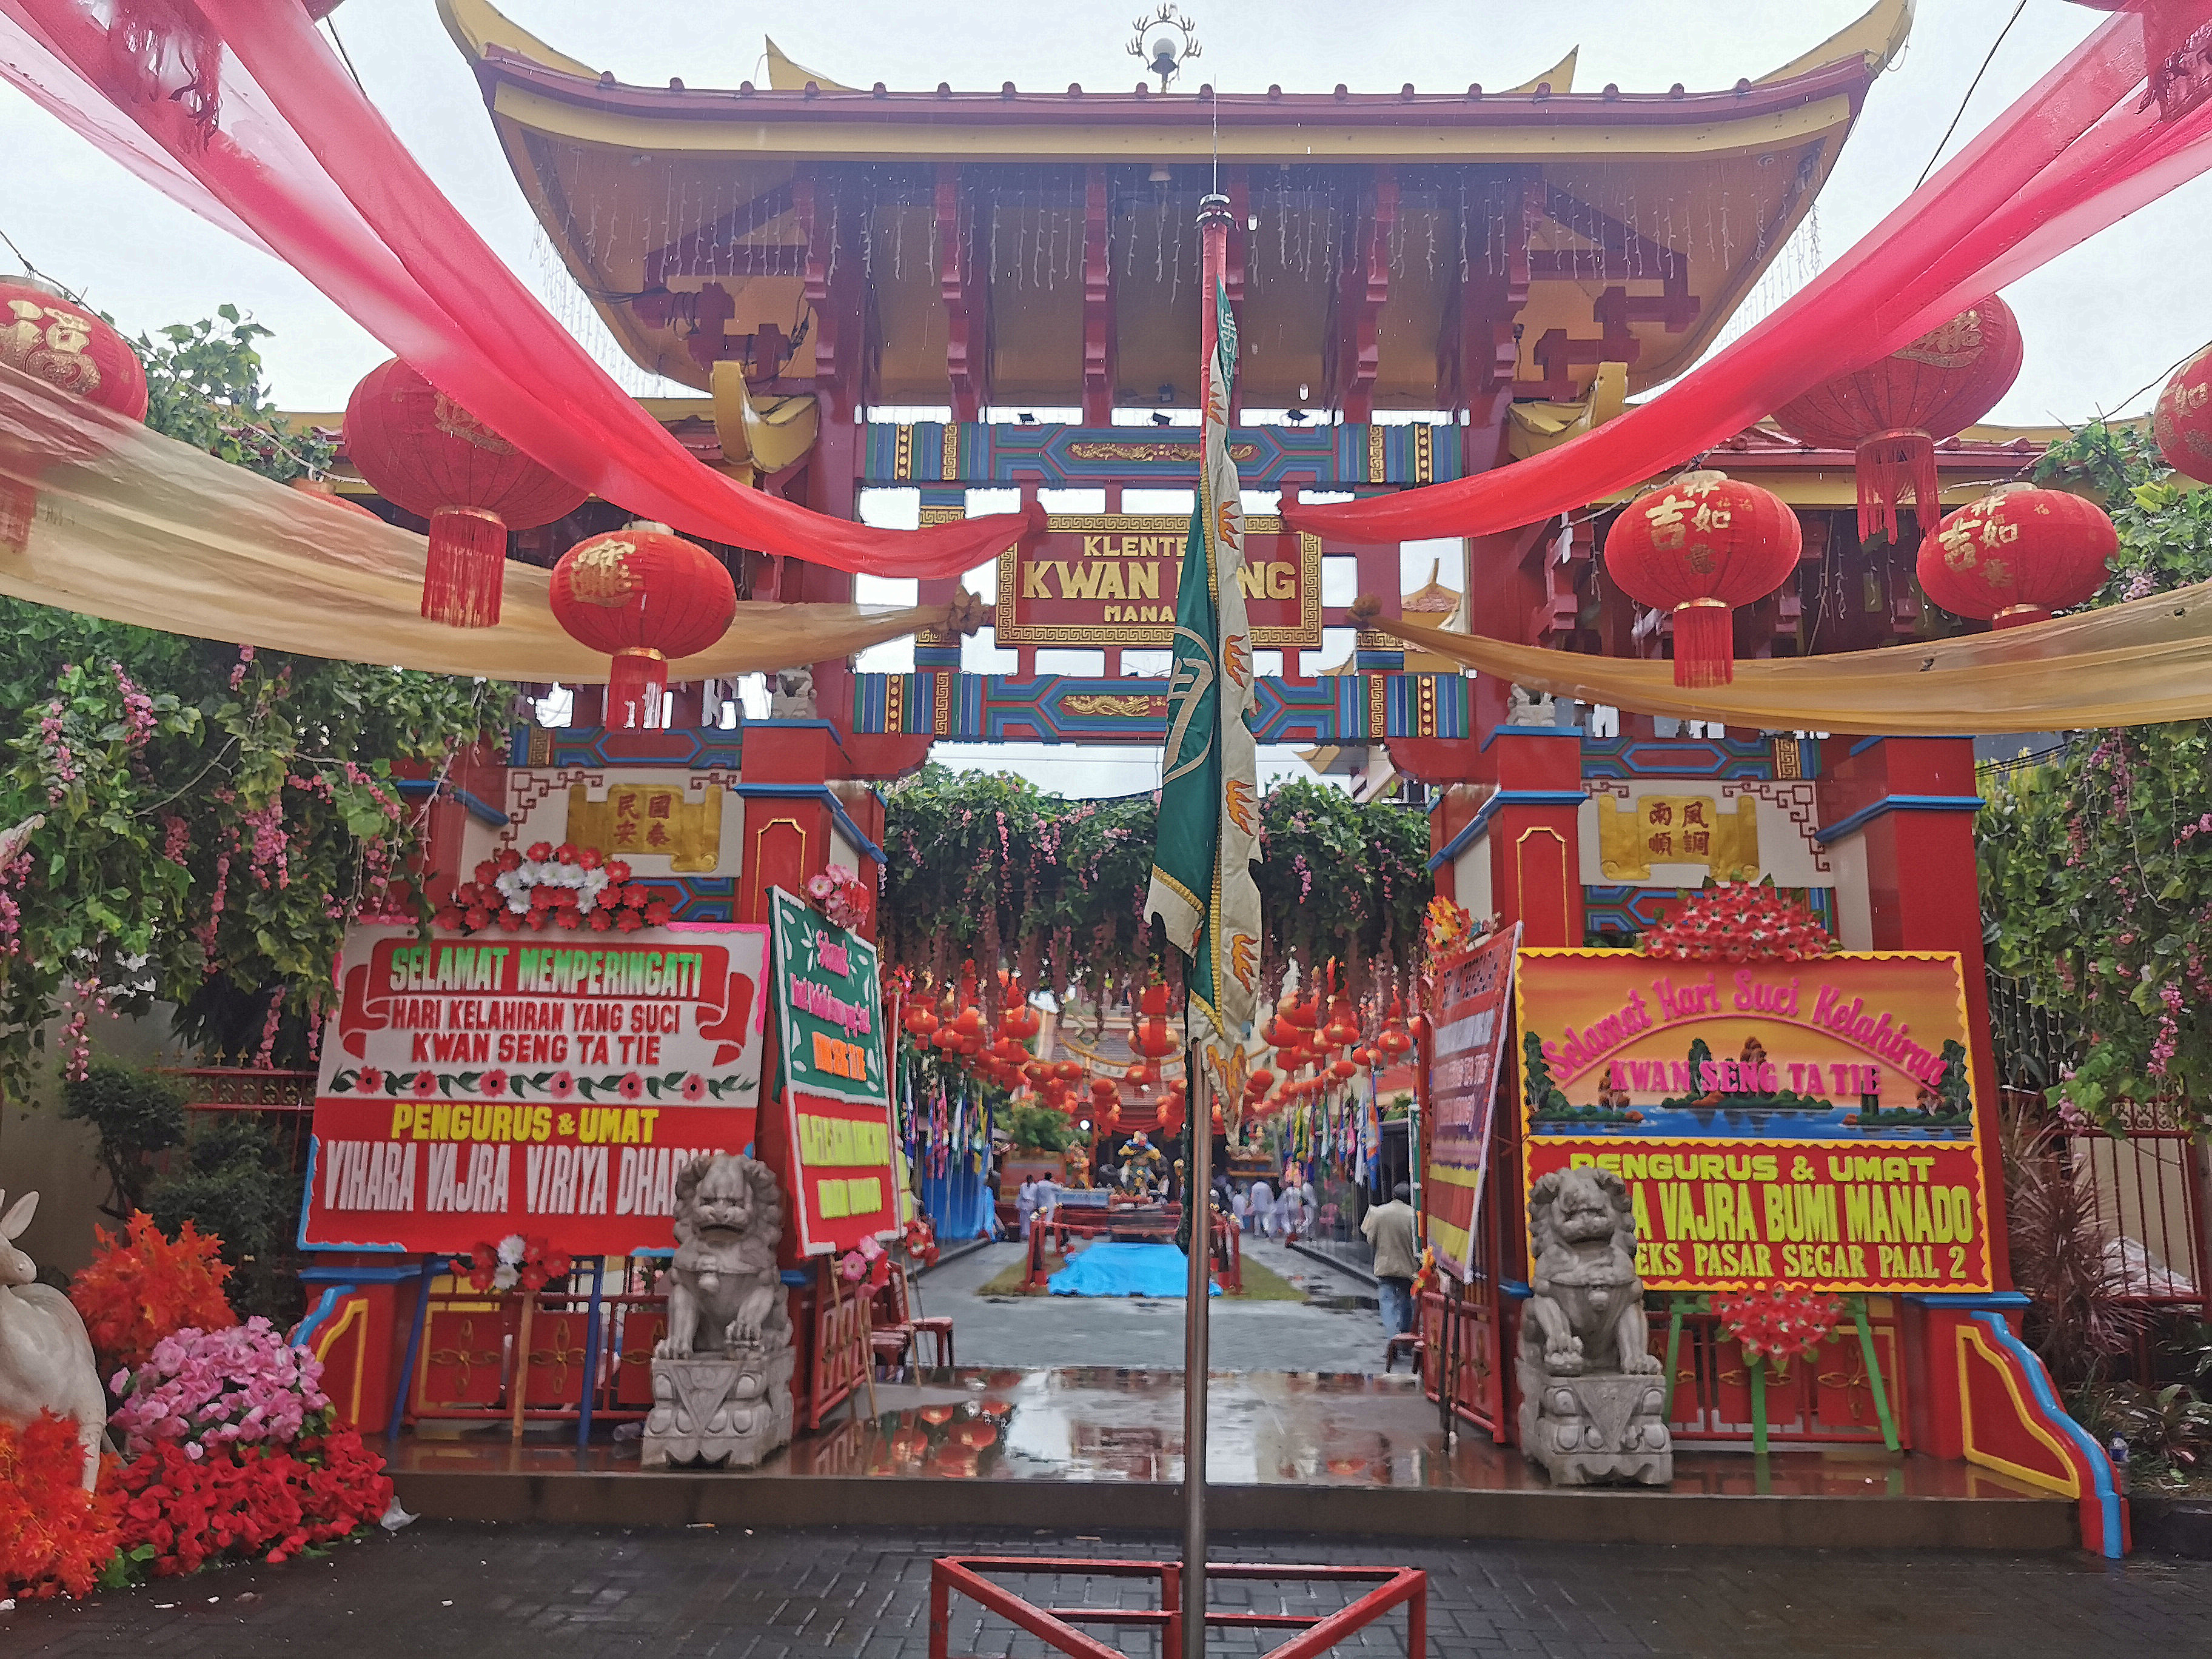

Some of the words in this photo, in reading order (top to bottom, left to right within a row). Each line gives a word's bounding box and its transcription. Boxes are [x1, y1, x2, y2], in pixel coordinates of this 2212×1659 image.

[1083, 536, 1187, 557] KLENTE
[1022, 560, 1160, 600] KWAN
[1176, 561, 1296, 600] NG
[1104, 605, 1175, 623] MANA
[389, 946, 509, 993] SELAMAT
[518, 947, 702, 997] MEMPERINGATI
[392, 998, 441, 1031] HARI
[448, 1000, 564, 1032] KELAHIRAN
[572, 1003, 623, 1033] YANG
[631, 1004, 680, 1034] SUCI
[1540, 988, 1653, 1079] Selamat
[1651, 974, 1721, 1019] Hari
[1733, 970, 1800, 1016] Suci
[1813, 984, 1948, 1085] Kelahiran
[412, 1033, 491, 1064] KWAN
[498, 1034, 567, 1064] SENG
[577, 1035, 606, 1065] TA
[617, 1035, 661, 1065] TIE
[1610, 1059, 1691, 1092] KWAN
[1699, 1061, 1778, 1093] SENG
[1788, 1062, 1823, 1095] TA
[1828, 1064, 1882, 1096] TIE
[390, 1103, 551, 1142] PENGURUS
[558, 1112, 575, 1136] &
[580, 1108, 659, 1144] UMAT
[324, 1140, 417, 1211] VIHARA
[427, 1142, 511, 1213] VAJRA
[526, 1144, 608, 1215] VIRIYA
[1570, 1153, 1778, 1182] PENGURUS
[1791, 1156, 1815, 1182] &
[1828, 1156, 1936, 1182] UMAT
[1660, 1182, 1758, 1240] VAJRA
[1765, 1183, 1837, 1242] BUMI
[1847, 1185, 1973, 1244] MANADO
[1694, 1243, 1772, 1278] PASAR
[1781, 1244, 1868, 1279] SEGAR
[1879, 1245, 1940, 1279] PAAL
[1949, 1245, 1967, 1279] 2
